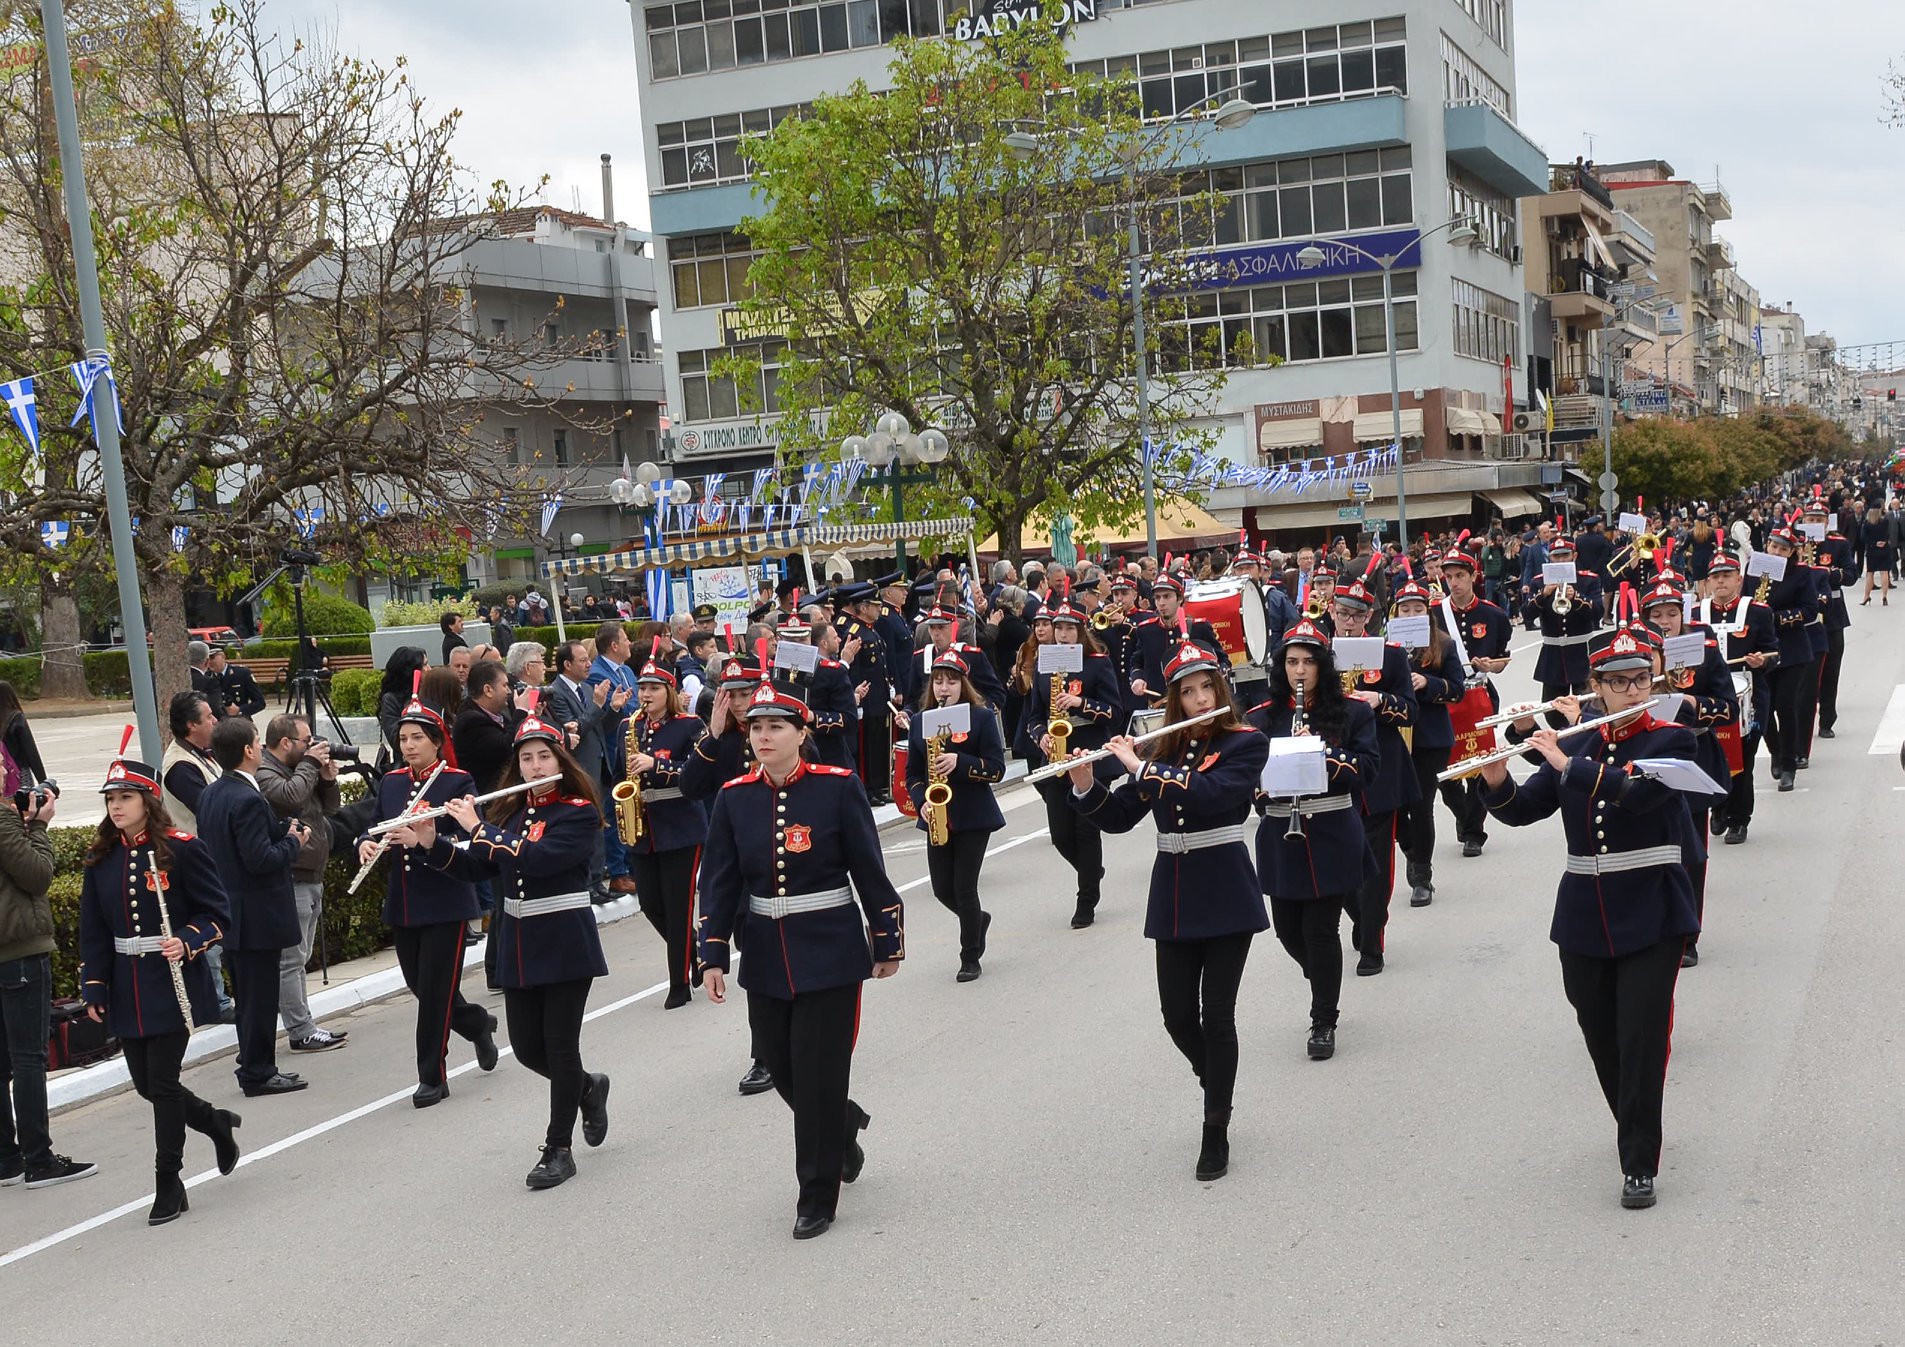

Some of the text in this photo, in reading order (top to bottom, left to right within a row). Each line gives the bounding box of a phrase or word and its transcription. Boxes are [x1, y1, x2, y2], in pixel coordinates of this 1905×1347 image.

[955, 0, 1096, 41] BABYLON
[1227, 244, 1360, 278] ΑΣΦΑΛΙΙΚΗ
[1261, 402, 1313, 417] ΜΥΣΤΑΚΙΔΗΣ
[703, 427, 736, 449] ΣΥΓΧΡΟΝΟ
[738, 424, 762, 446] ΚΕΝΤΡΟ
